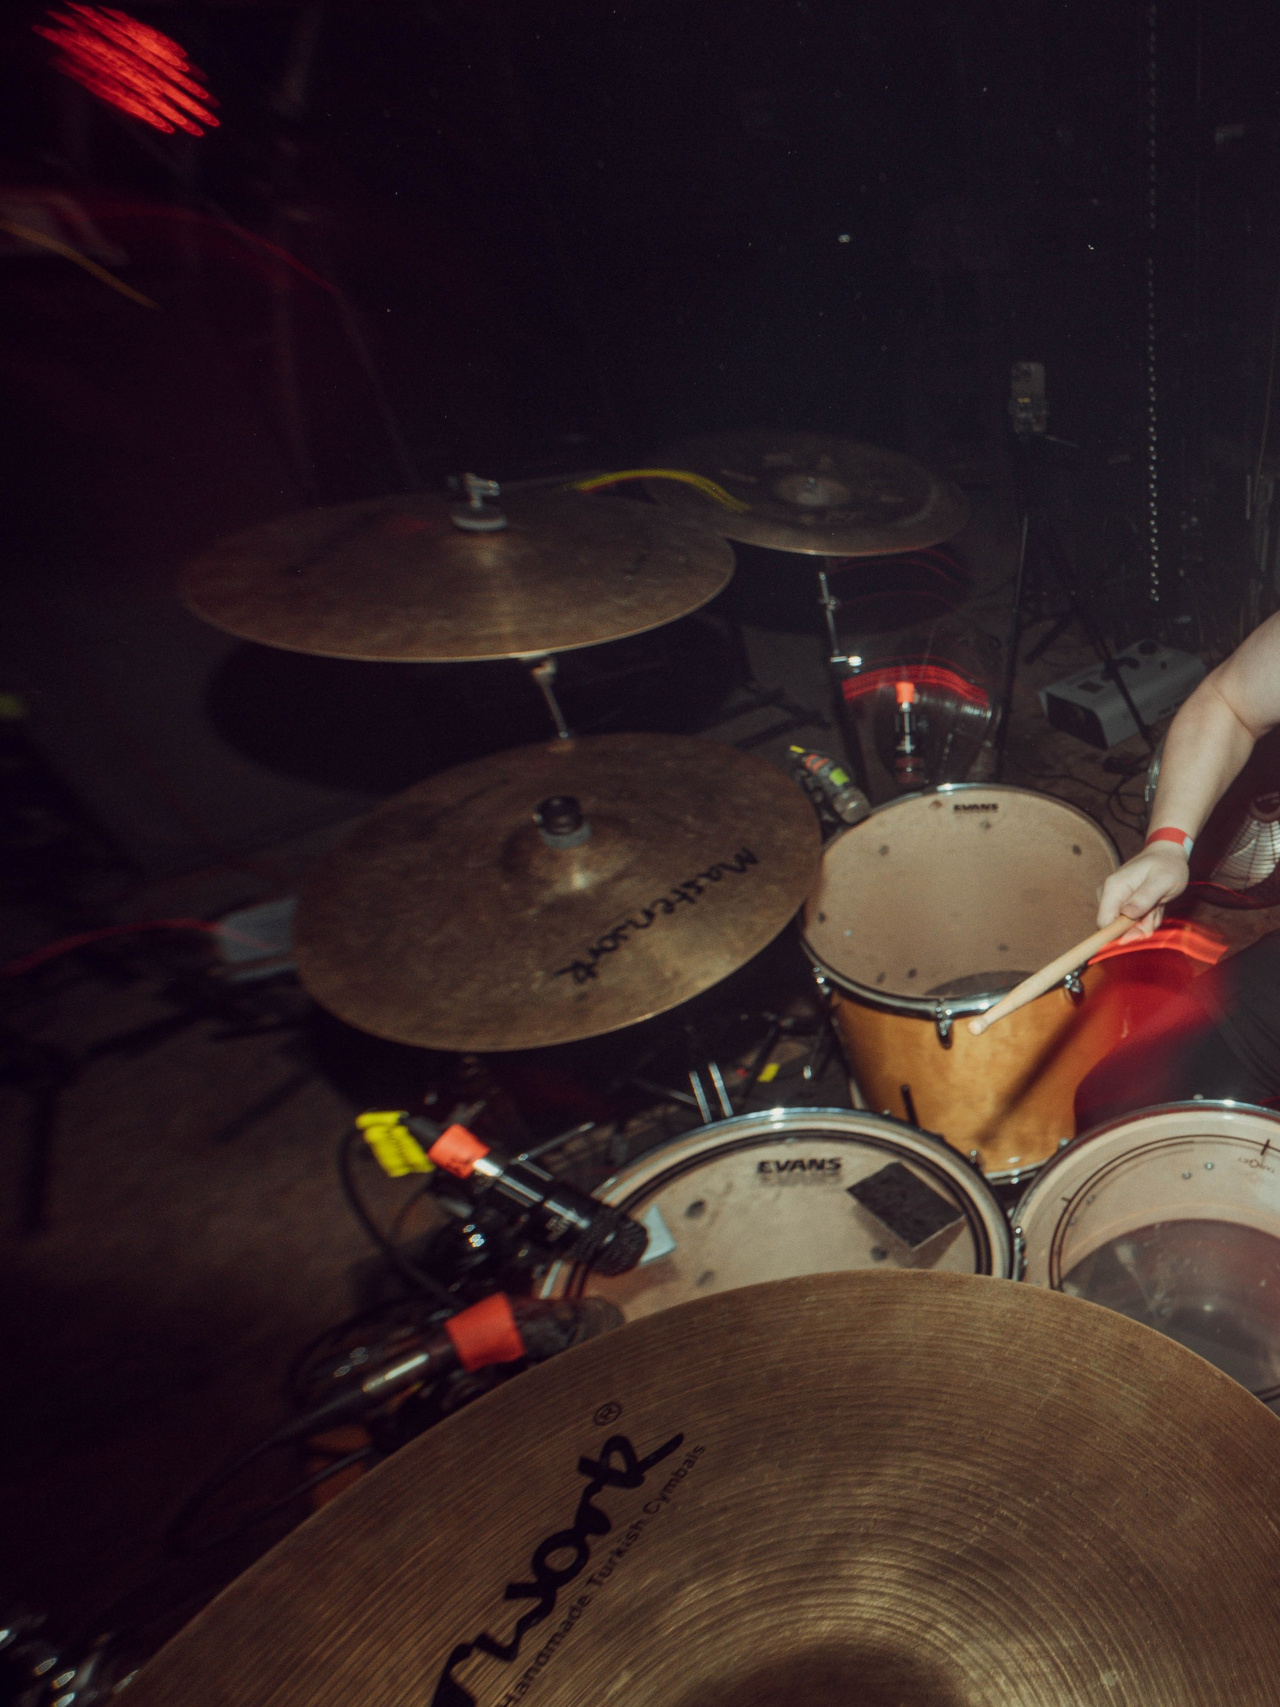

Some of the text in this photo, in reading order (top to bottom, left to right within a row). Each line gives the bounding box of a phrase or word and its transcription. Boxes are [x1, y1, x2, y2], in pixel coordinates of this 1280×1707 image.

[757, 1156, 842, 1174] EVANS
[586, 1516, 646, 1588] Turkish
[641, 1444, 706, 1516] Cymbals
